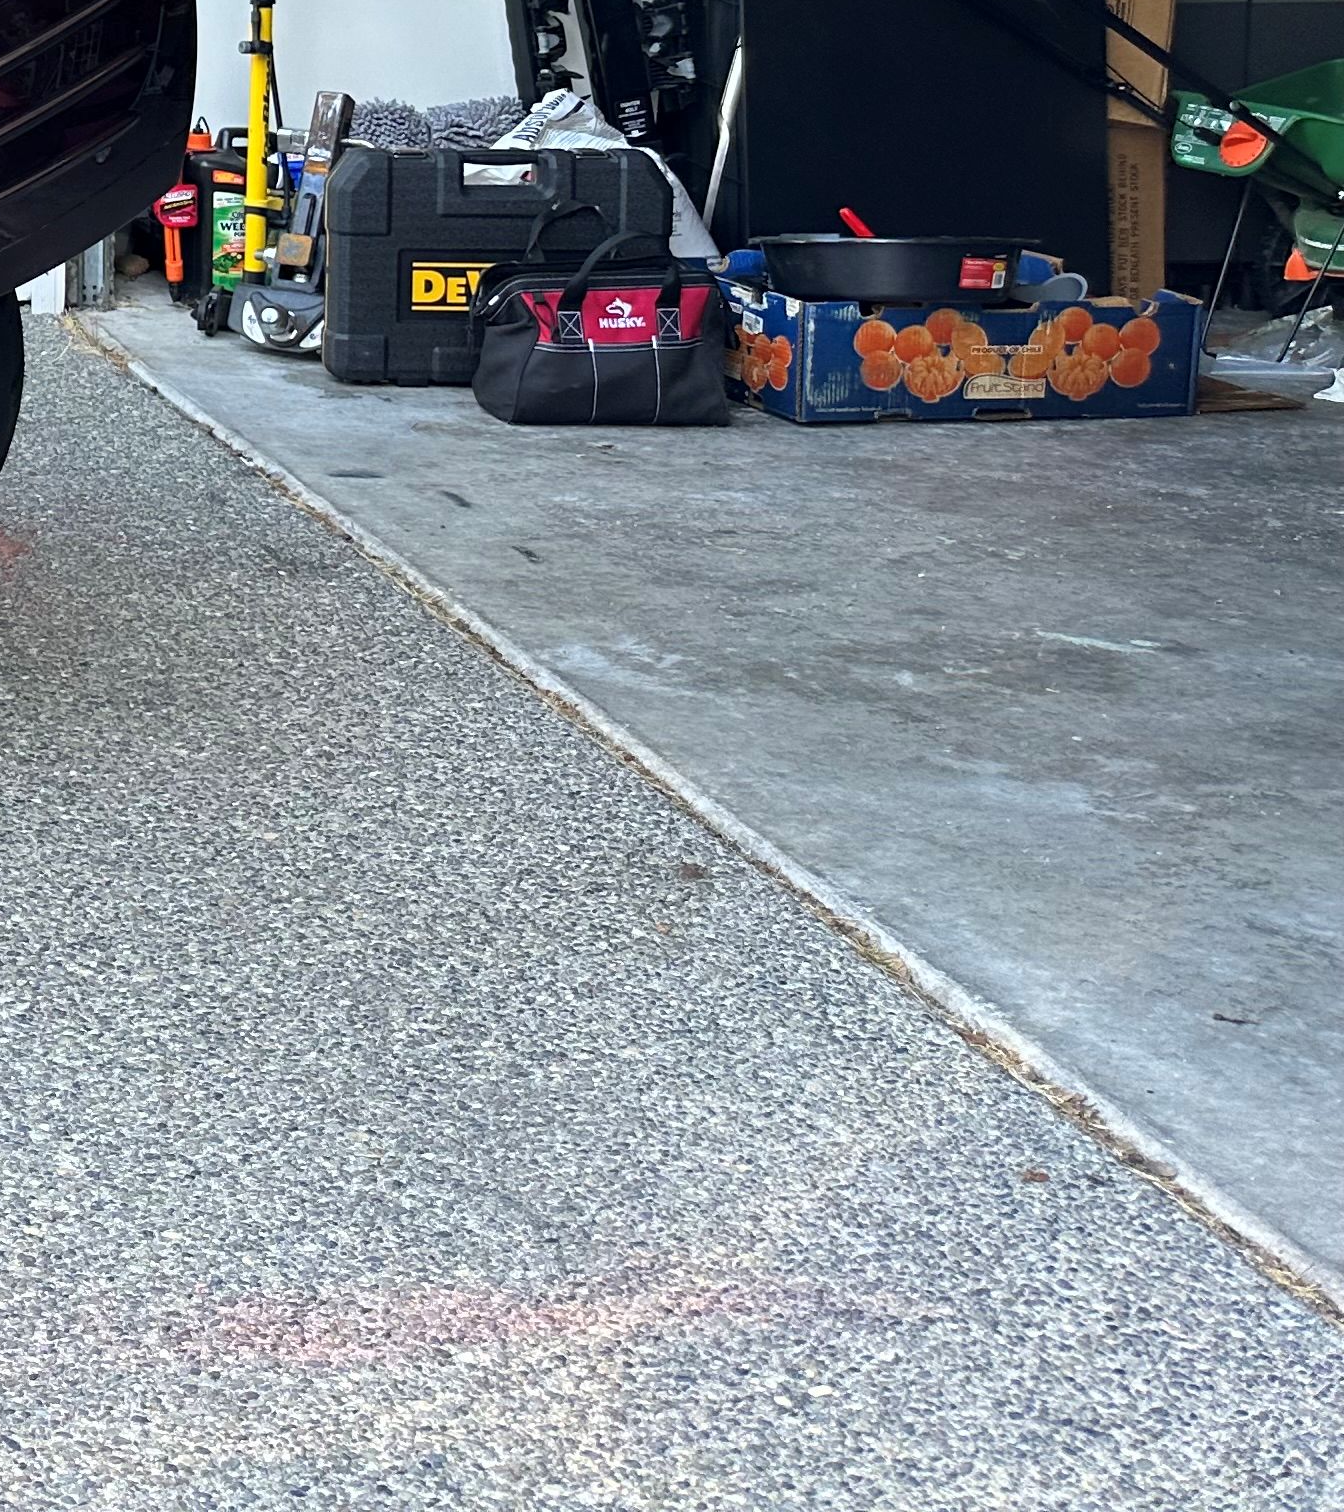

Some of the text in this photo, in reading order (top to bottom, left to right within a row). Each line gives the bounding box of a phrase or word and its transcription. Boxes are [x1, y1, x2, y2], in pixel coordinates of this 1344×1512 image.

[1130, 162, 1139, 192] STOCK
[1118, 193, 1128, 221] STOCK
[220, 222, 245, 232] WEE
[598, 316, 644, 329] HUSKY
[971, 346, 1042, 354] PRODUCT OF CHILE
